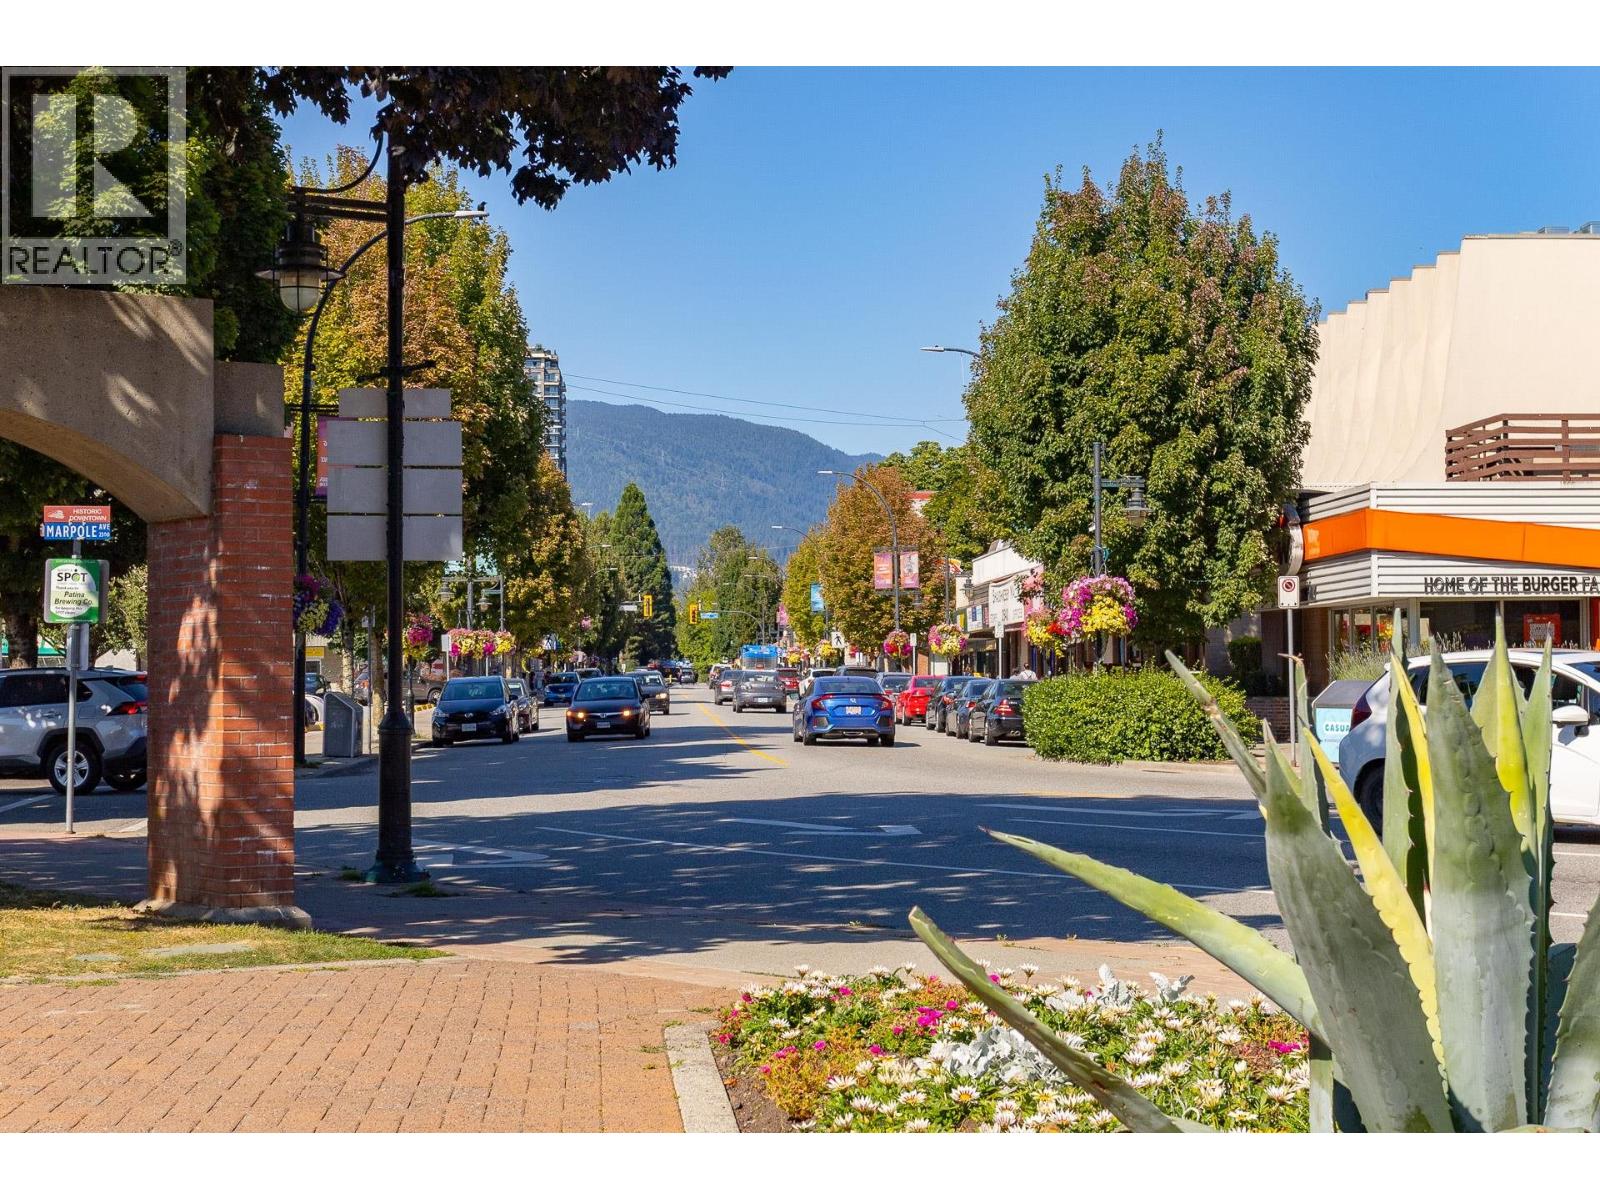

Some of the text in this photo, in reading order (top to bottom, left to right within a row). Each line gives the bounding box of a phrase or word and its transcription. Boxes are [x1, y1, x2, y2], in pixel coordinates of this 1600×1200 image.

[46, 525, 97, 538] MARPOLE
[56, 572, 88, 582] SPOT
[1424, 576, 1465, 594] HOME
[1468, 576, 1488, 594] OF
[1491, 576, 1518, 594] THE
[1522, 576, 1578, 593] BURGER
[63, 590, 85, 598] Patina
[54, 597, 82, 606] Brewing
